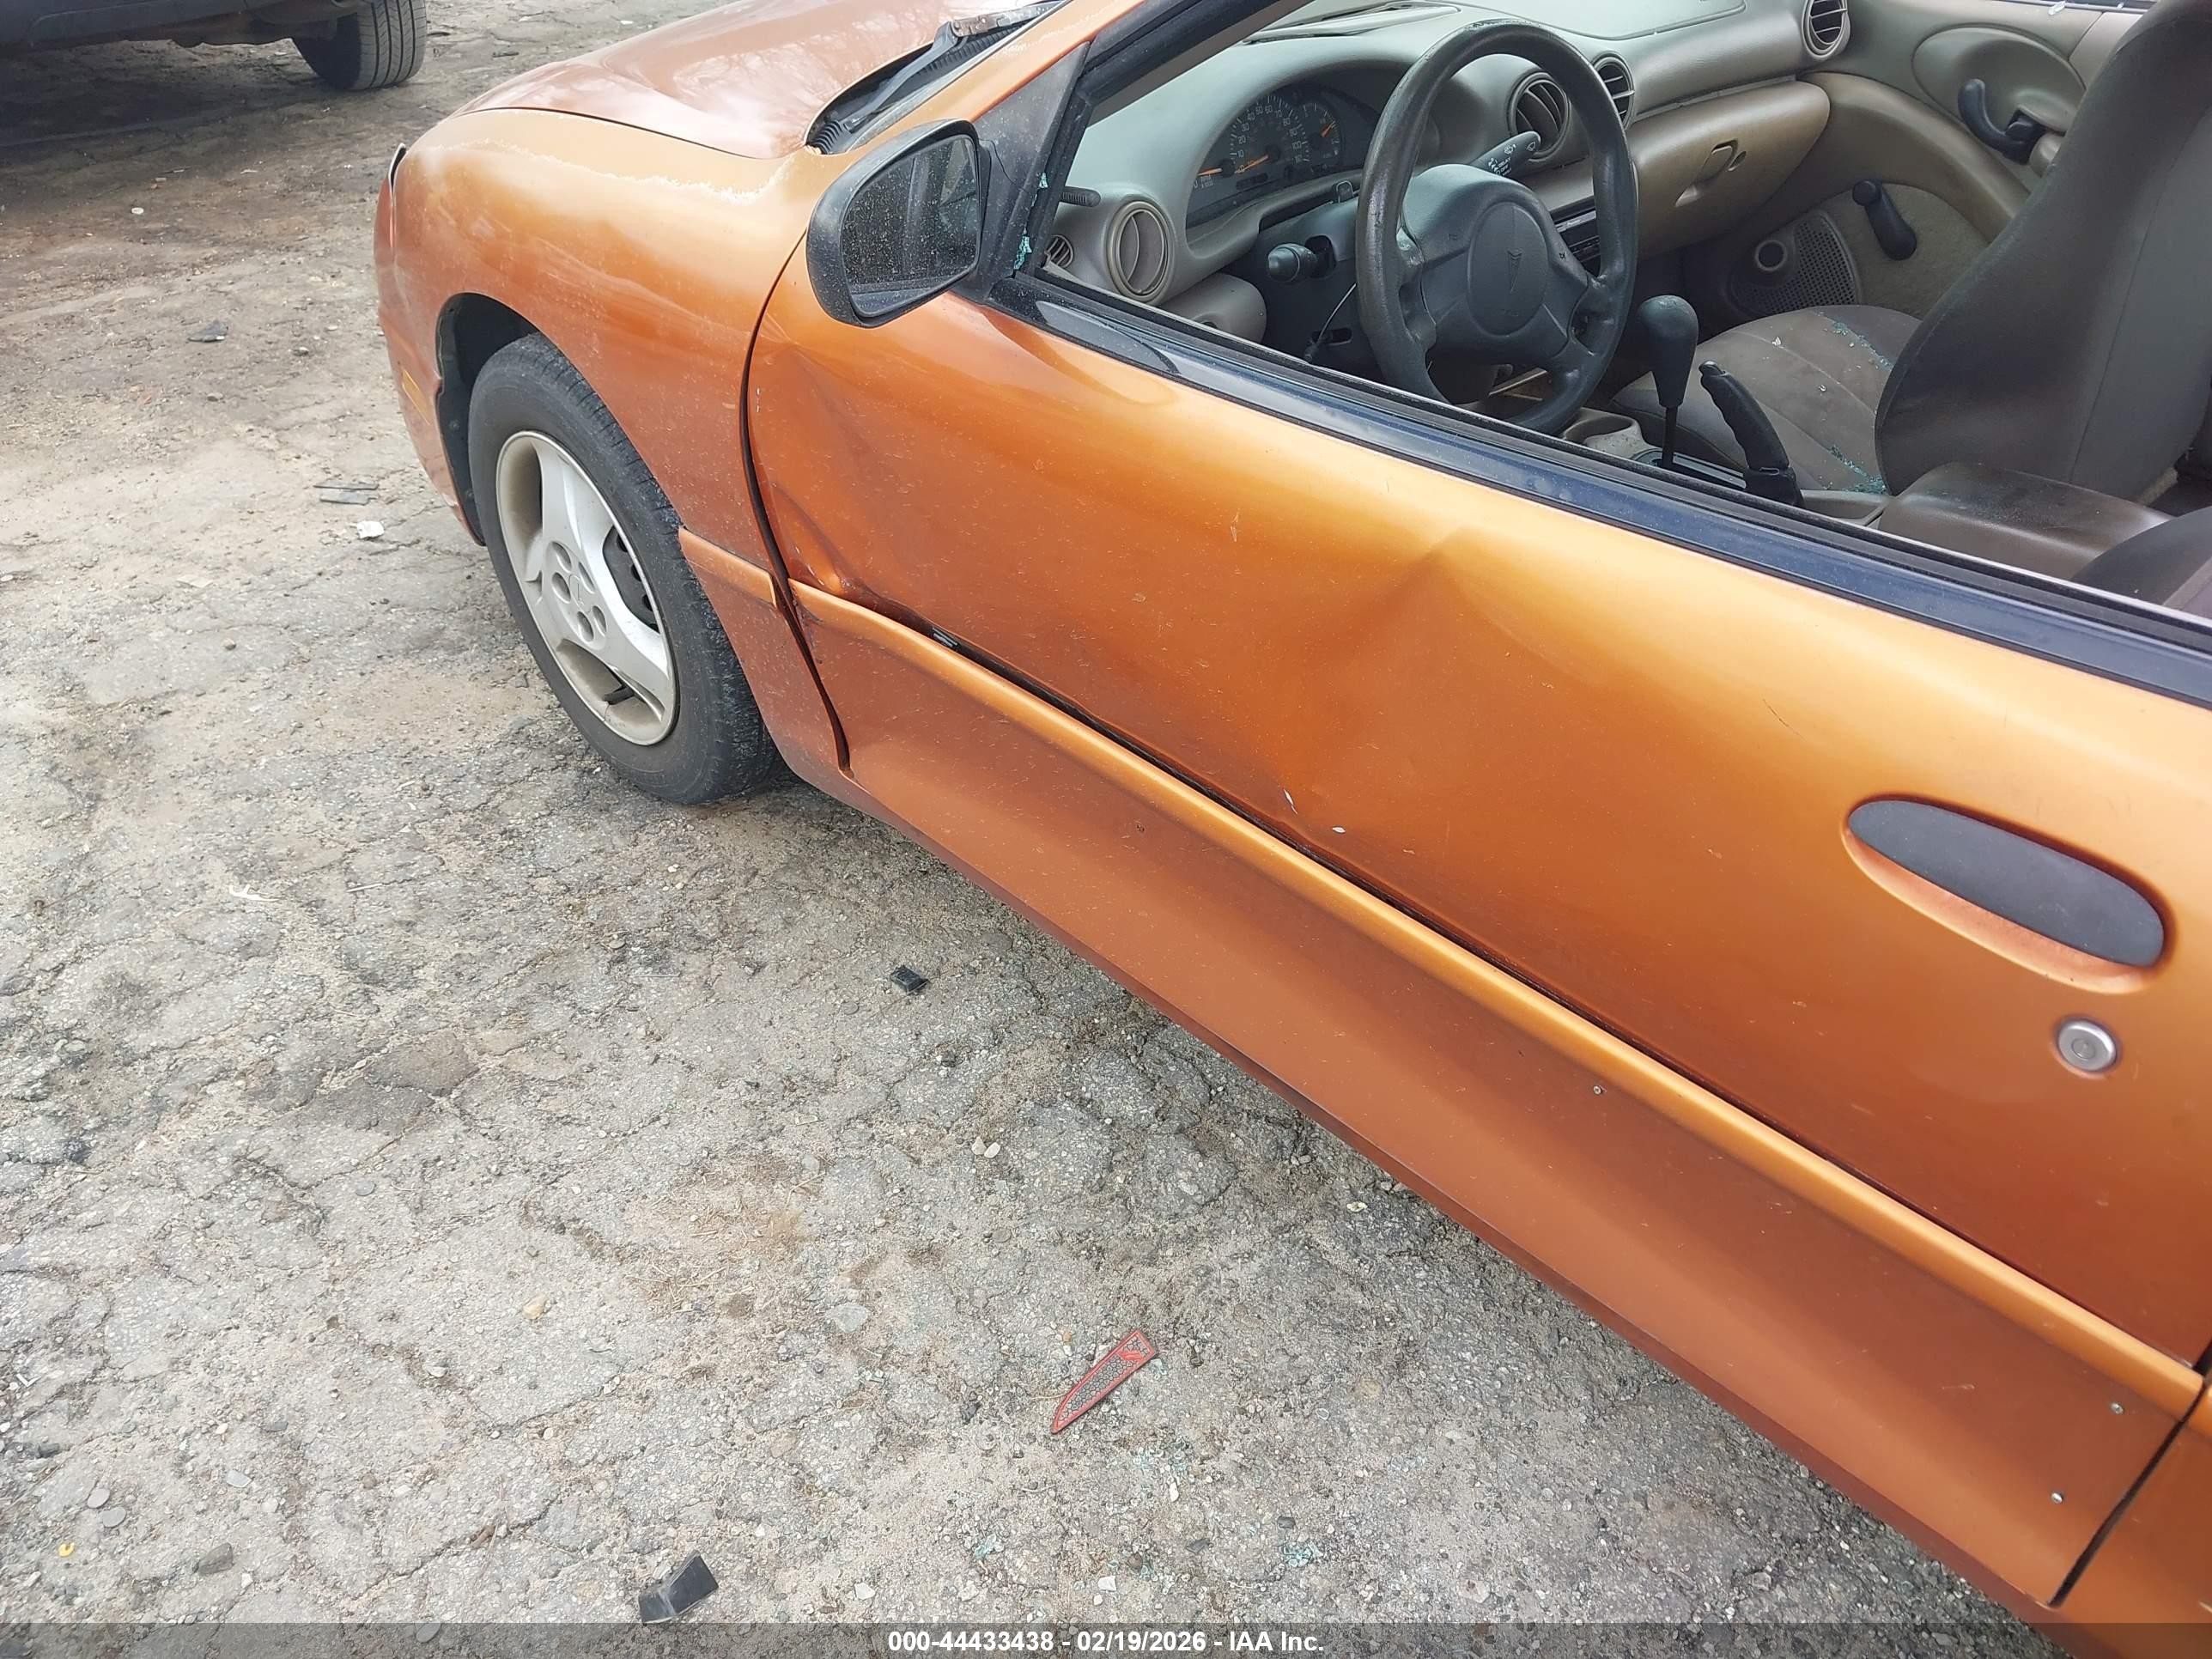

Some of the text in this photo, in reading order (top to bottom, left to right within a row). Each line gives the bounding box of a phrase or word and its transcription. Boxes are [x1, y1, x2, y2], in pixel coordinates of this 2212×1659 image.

[1274, 109, 1282, 118] 70
[1238, 135, 1246, 144] 20
[1291, 141, 1302, 149] 100
[1237, 149, 1244, 158] 10
